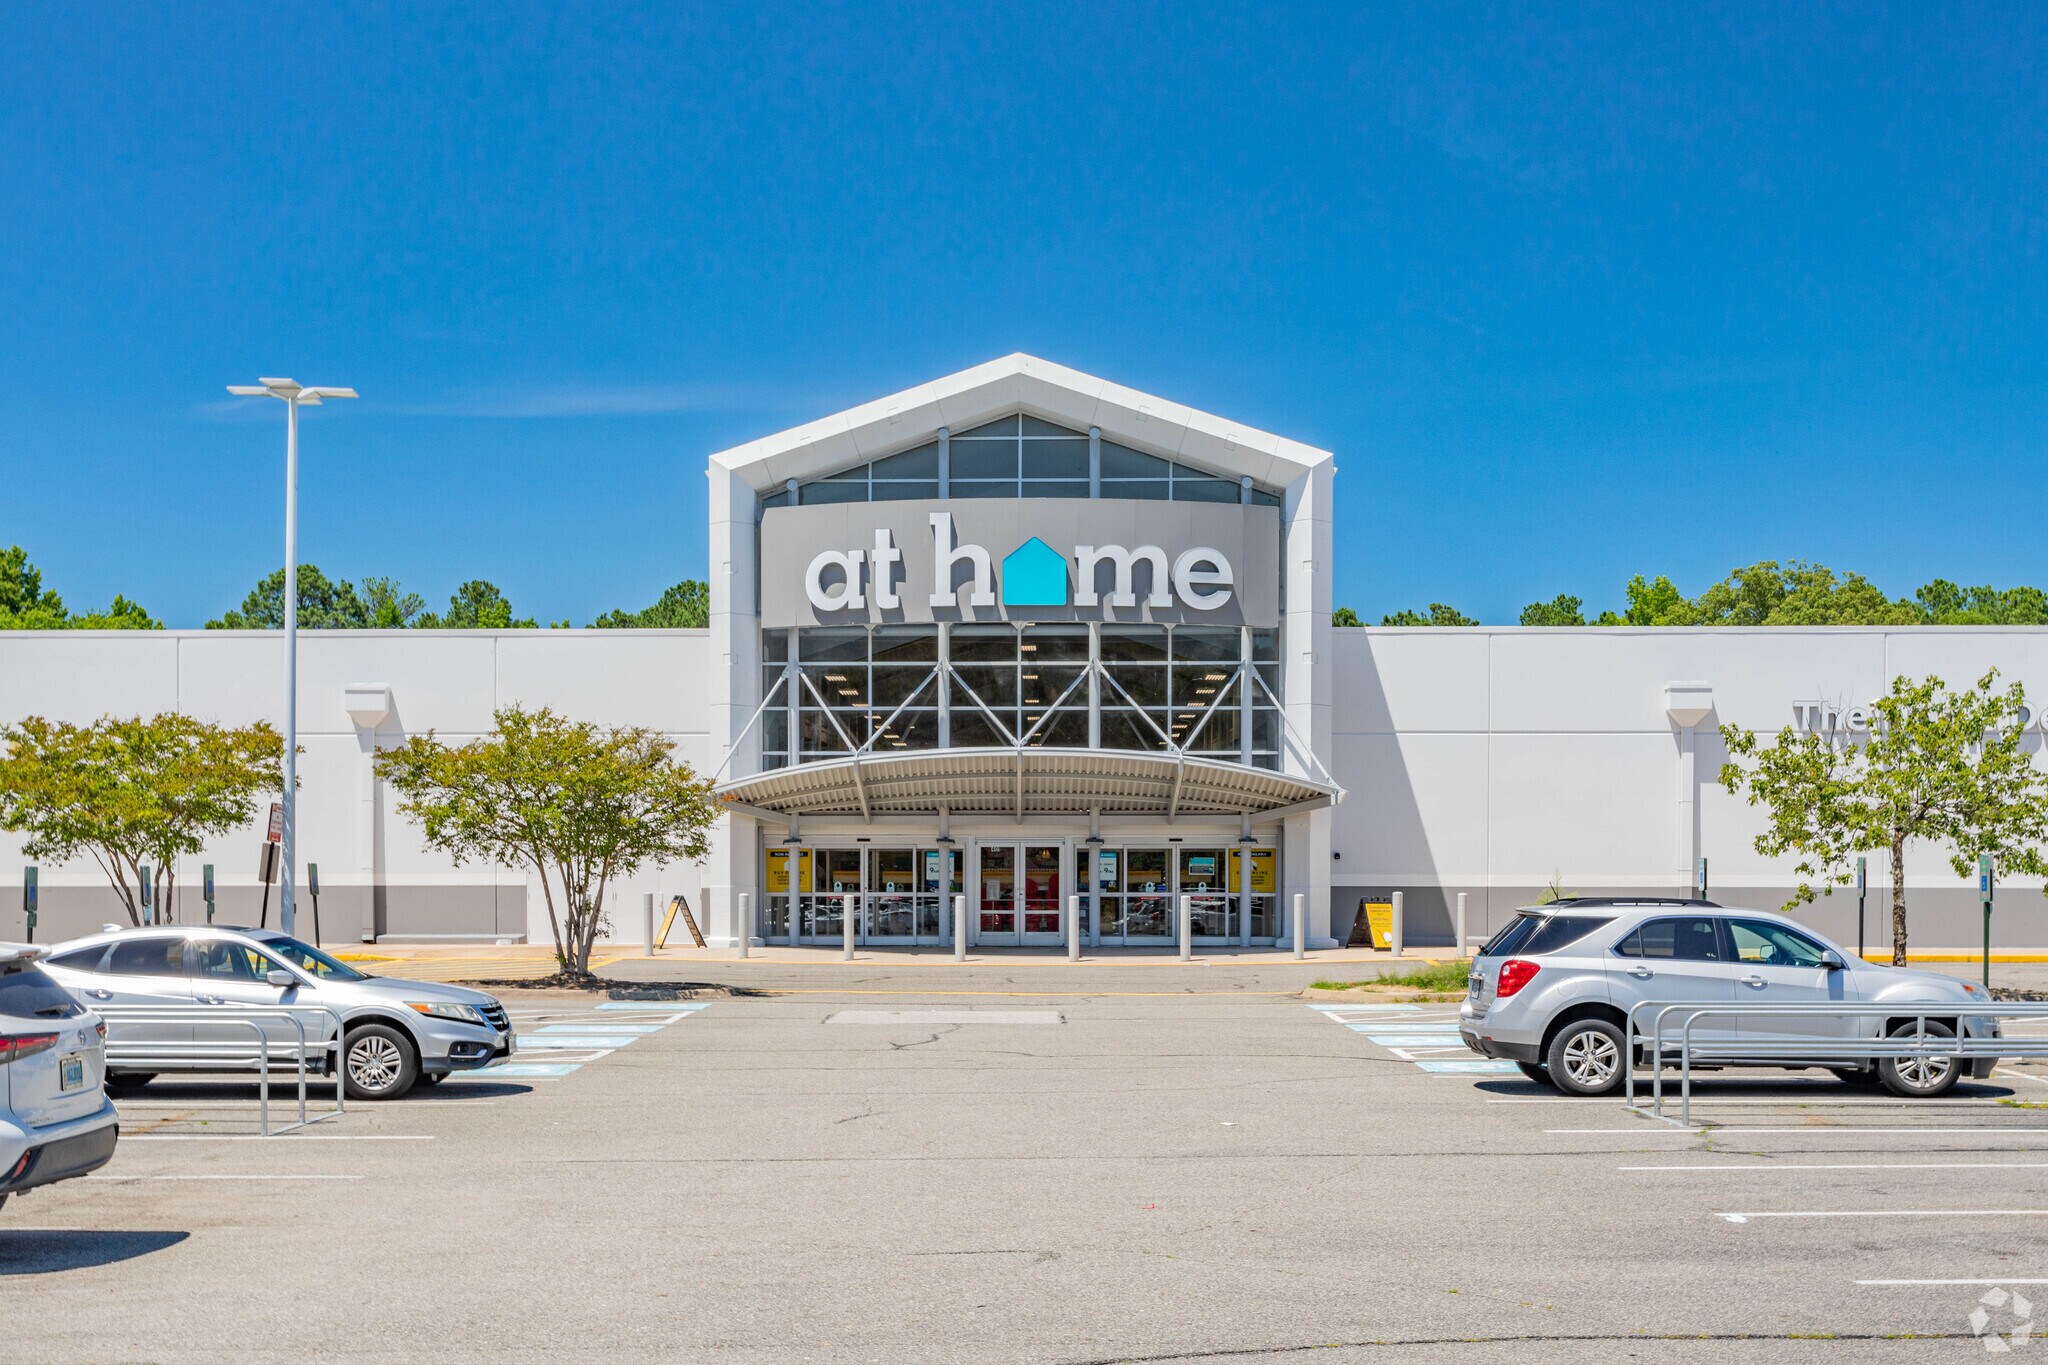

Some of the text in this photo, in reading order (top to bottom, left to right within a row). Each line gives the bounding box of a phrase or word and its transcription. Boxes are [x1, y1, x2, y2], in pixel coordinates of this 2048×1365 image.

[804, 527, 901, 612] at
[1793, 699, 1868, 731] The
[2010, 699, 2048, 731] D
